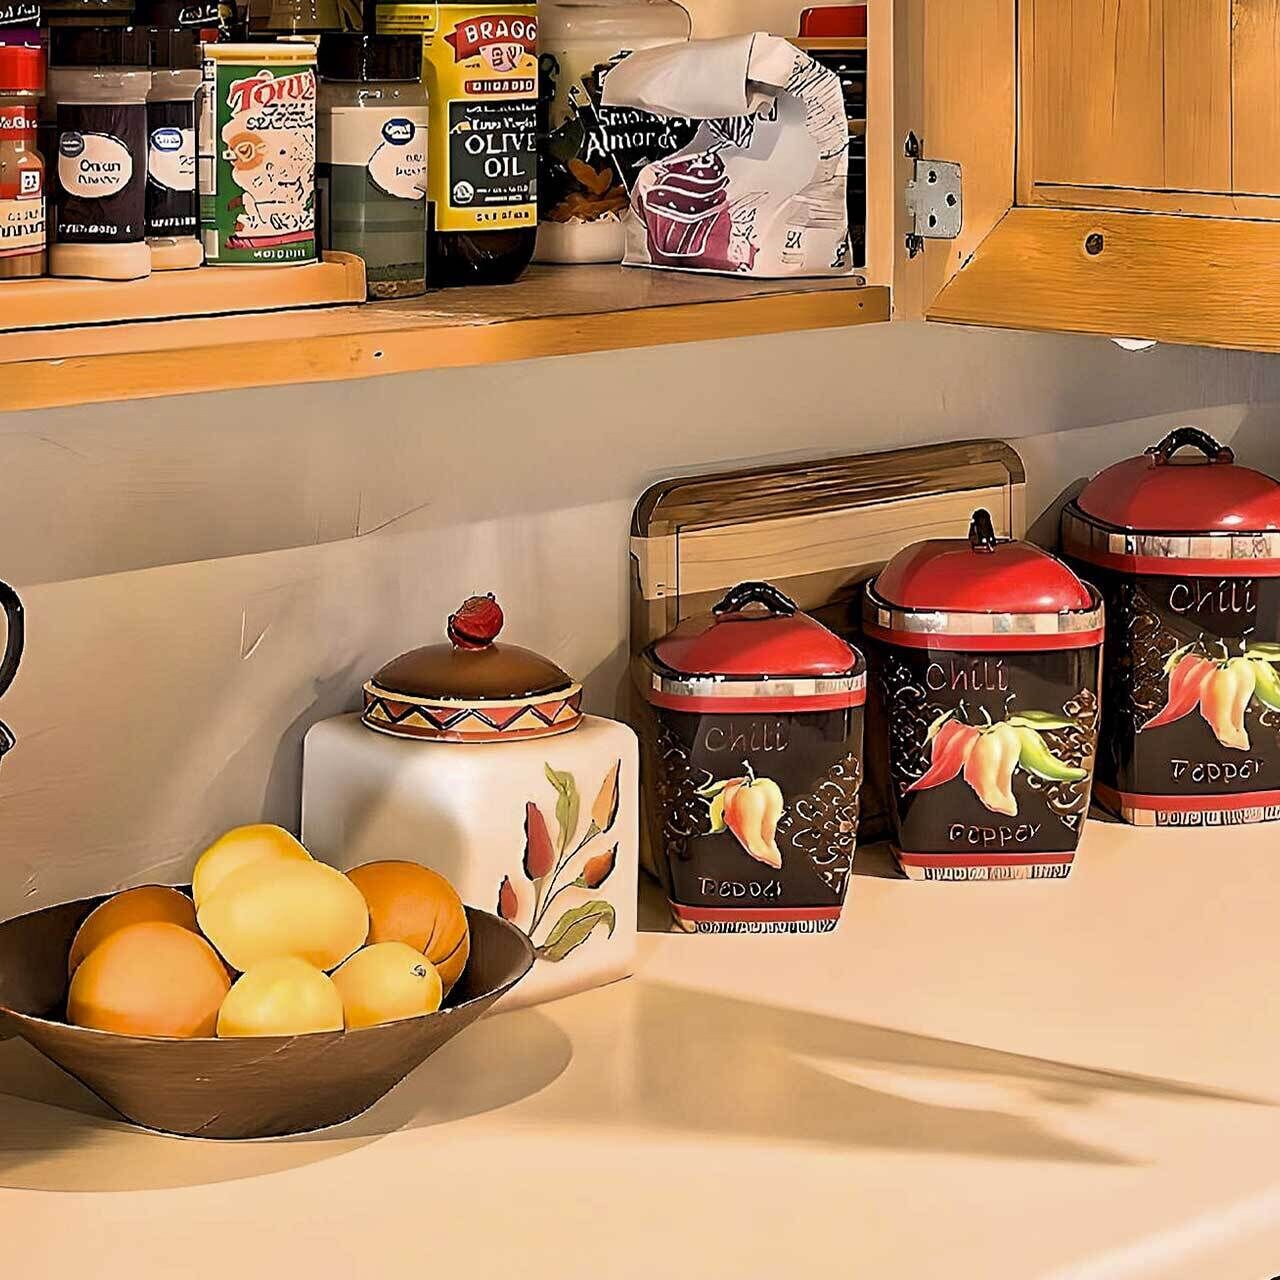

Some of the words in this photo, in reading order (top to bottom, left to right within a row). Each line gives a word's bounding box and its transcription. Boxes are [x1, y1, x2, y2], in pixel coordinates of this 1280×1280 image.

[464, 133, 537, 155] OLIVE
[484, 156, 526, 178] OIL
[1170, 579, 1256, 613] Chili
[926, 659, 1008, 691] Chili
